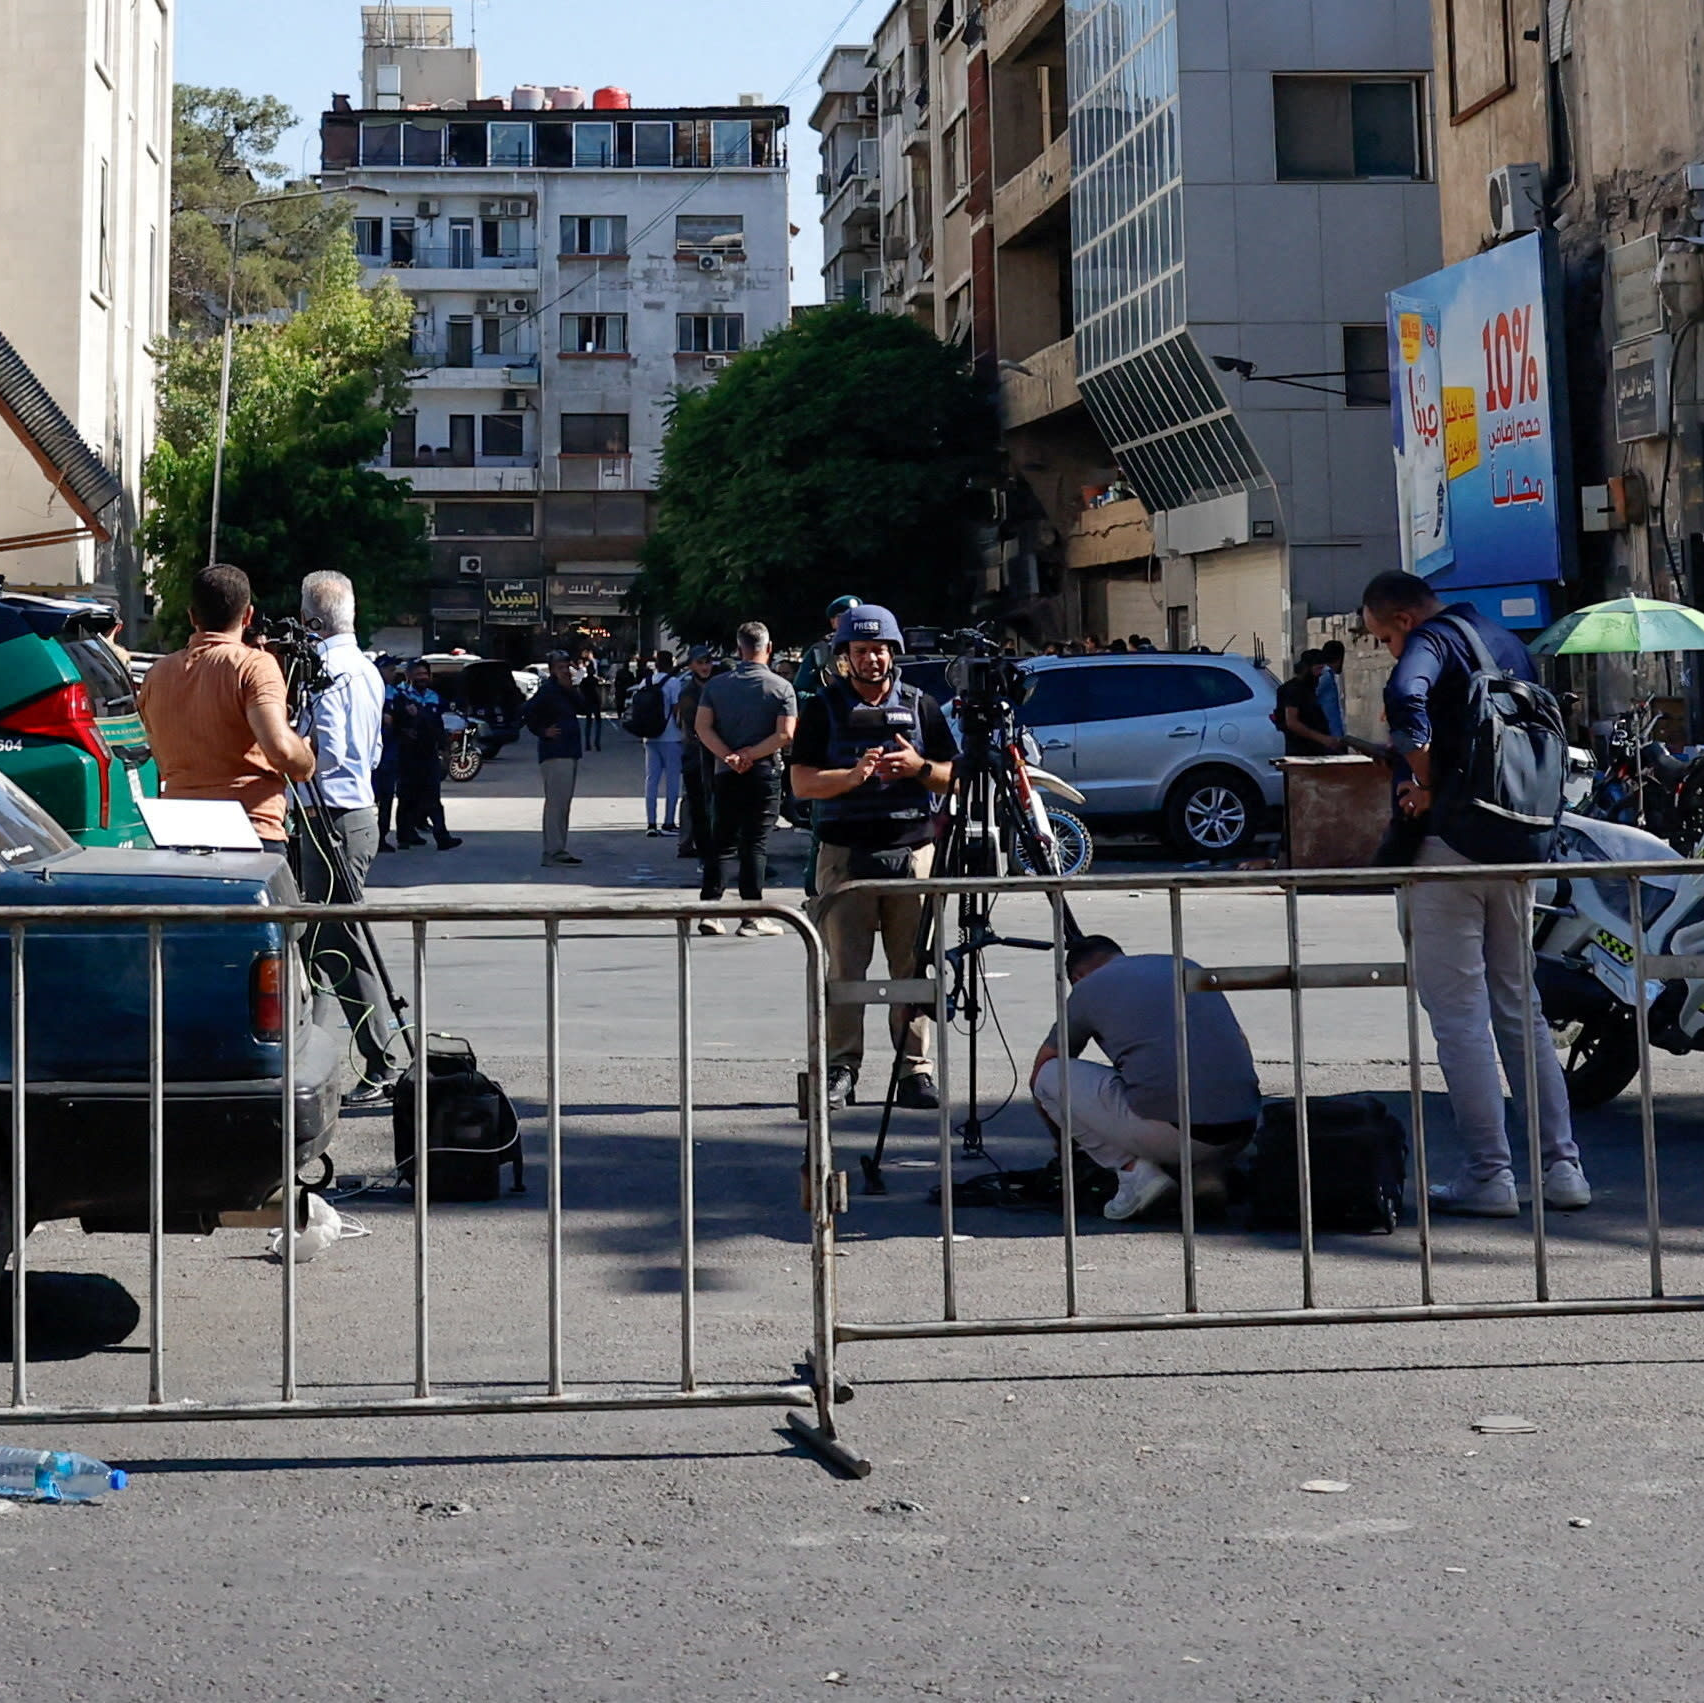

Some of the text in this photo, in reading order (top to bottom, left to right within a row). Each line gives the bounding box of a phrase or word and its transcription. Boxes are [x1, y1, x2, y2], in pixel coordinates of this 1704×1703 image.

[1482, 303, 1539, 413] 10%
[1516, 416, 1542, 446] حجم
[853, 621, 879, 632] PRESS
[887, 712, 913, 723] PRESS
